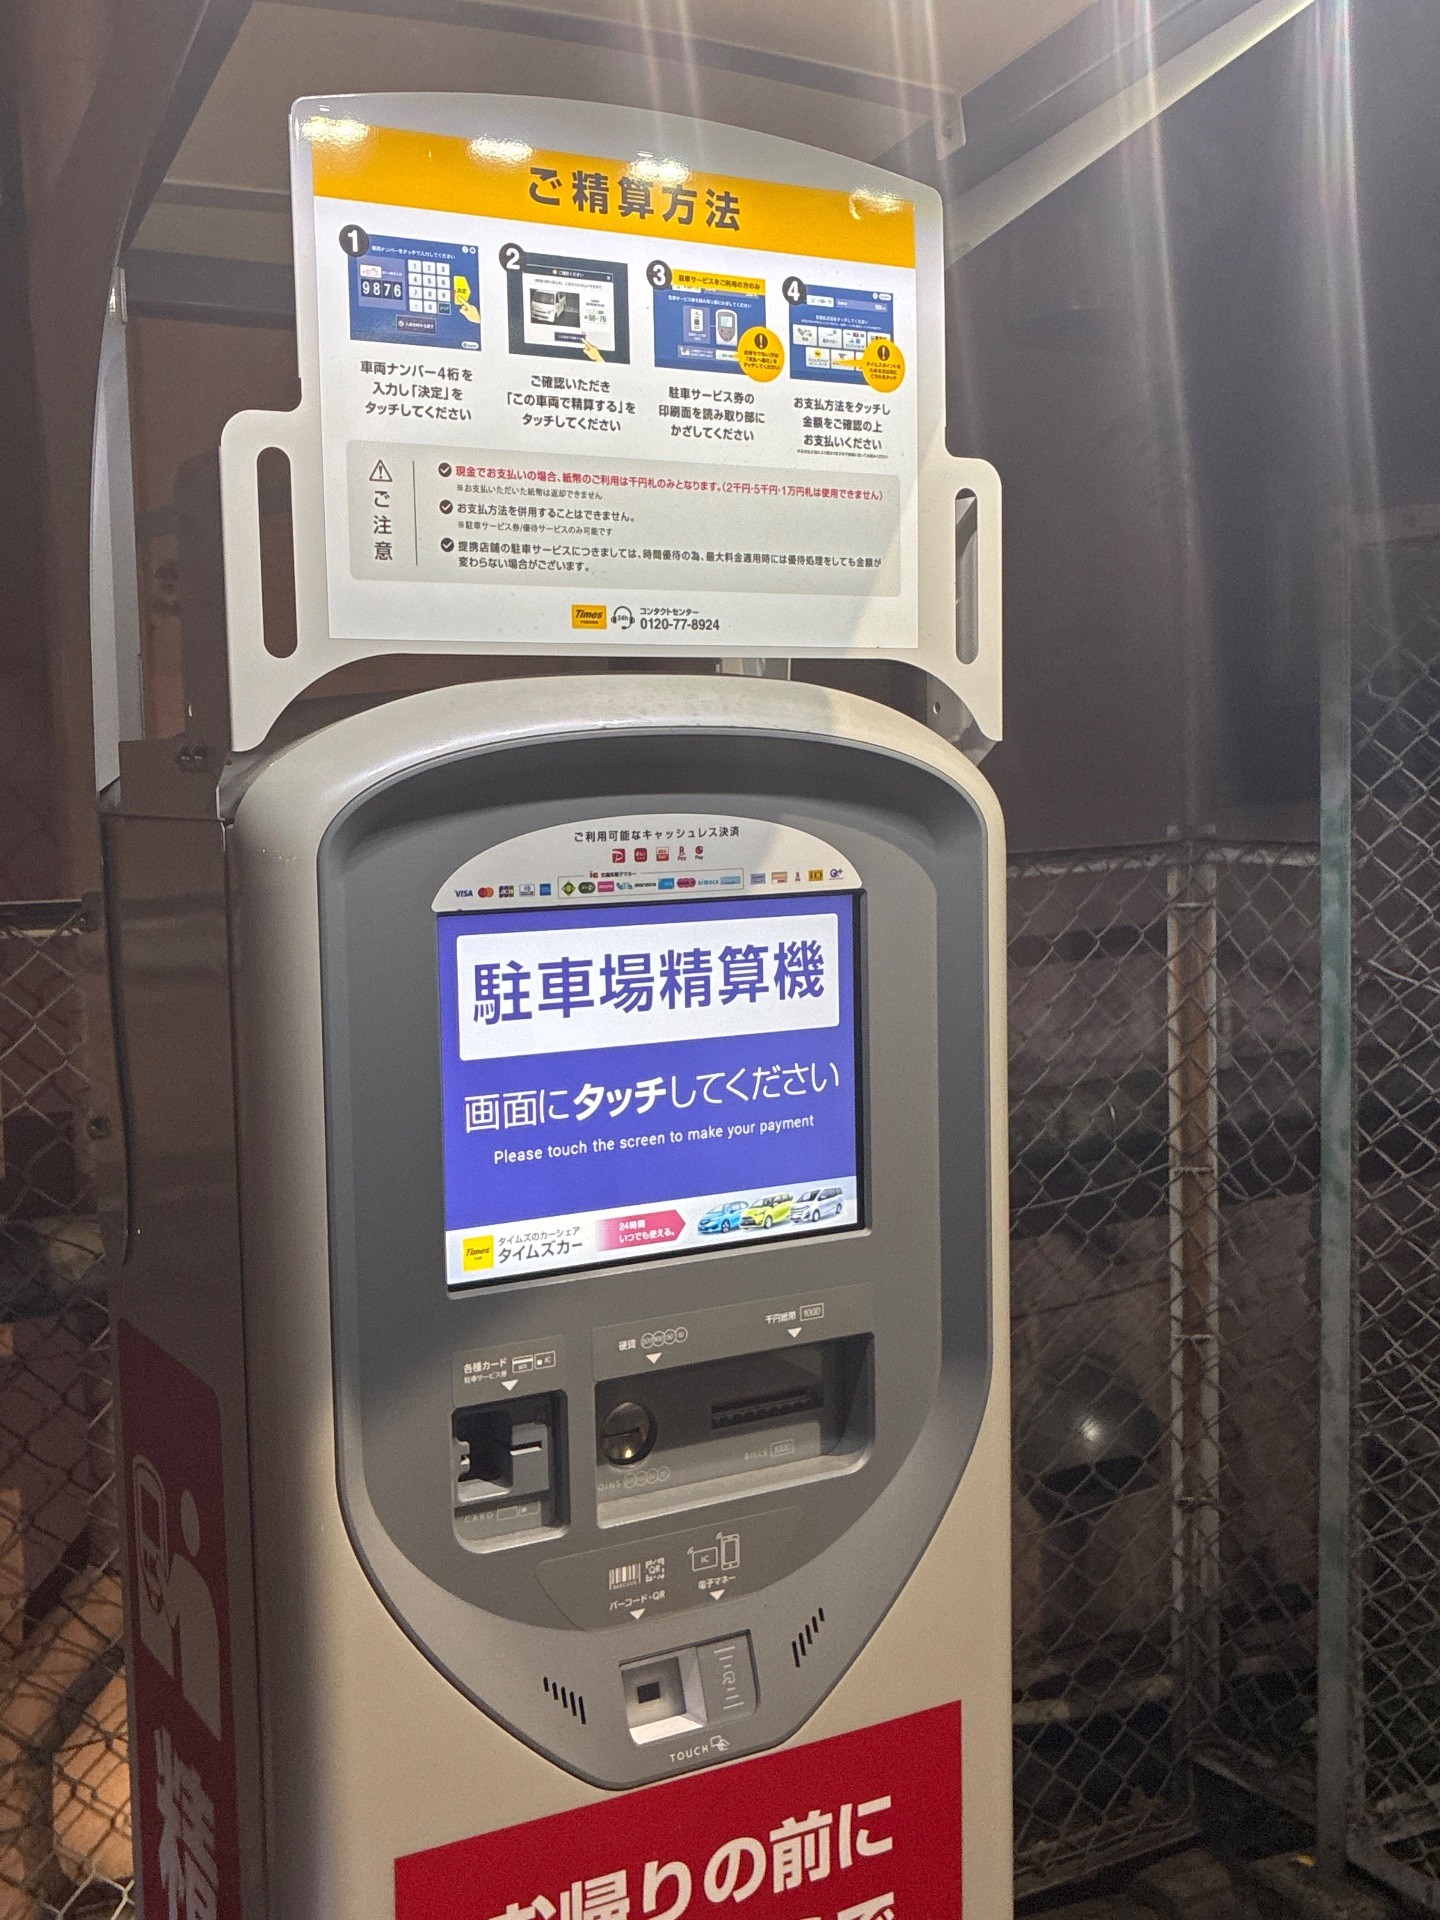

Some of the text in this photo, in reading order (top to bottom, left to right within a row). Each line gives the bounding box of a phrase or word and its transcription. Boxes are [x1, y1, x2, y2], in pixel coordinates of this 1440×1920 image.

[529, 167, 740, 231] ご精算方法
[347, 229, 358, 252] 1
[506, 247, 520, 270] 2
[652, 264, 666, 286] 3
[362, 281, 402, 298] 9876
[787, 280, 800, 301] 4
[360, 360, 473, 382] 車両ナンバー4桁を
[372, 382, 463, 401] 入力し「決定」を
[530, 374, 611, 393] ご確認いただき
[506, 391, 636, 415] 「この車両で精算する」を
[668, 386, 755, 405] 駐車サービス券の
[364, 401, 472, 421] タッチしてください
[658, 404, 766, 424] 印刷面を読み取り部に
[793, 397, 891, 416] お支払方法をタッチし
[522, 413, 622, 432] タッチしてください
[802, 416, 883, 433] 金額をご確認の上
[670, 424, 755, 442] かざしてください
[803, 434, 882, 451] お支払いください
[456, 503, 635, 522] お支払方法を併用することはできません。
[373, 490, 393, 561] ご注意
[458, 556, 590, 573] 変わらない場合がございます。
[575, 609, 603, 619] Times
[640, 607, 699, 617] コンタクトセンター
[640, 617, 720, 631] 0120-77-8924
[574, 825, 740, 842] ご利用可能なキャッシュレス決済
[454, 889, 474, 898] VISA
[472, 939, 825, 1026] 駐車場精算機
[464, 1061, 840, 1134] 画面にタッチしてください
[494, 1114, 814, 1164] Please touch the screen to make your payment
[618, 1219, 646, 1231] 24時間
[498, 1226, 580, 1246] タイムズのカーシェア
[619, 1230, 675, 1244] いつでも使える。
[465, 1246, 490, 1257] Times
[498, 1240, 583, 1264] タイムズカー
[463, 1357, 507, 1374] 各種カード
[700, 1555, 709, 1563] IC
[648, 1565, 661, 1574] QR
[609, 1590, 666, 1611] バーコード・QR
[670, 1744, 709, 1763] TOUCH
